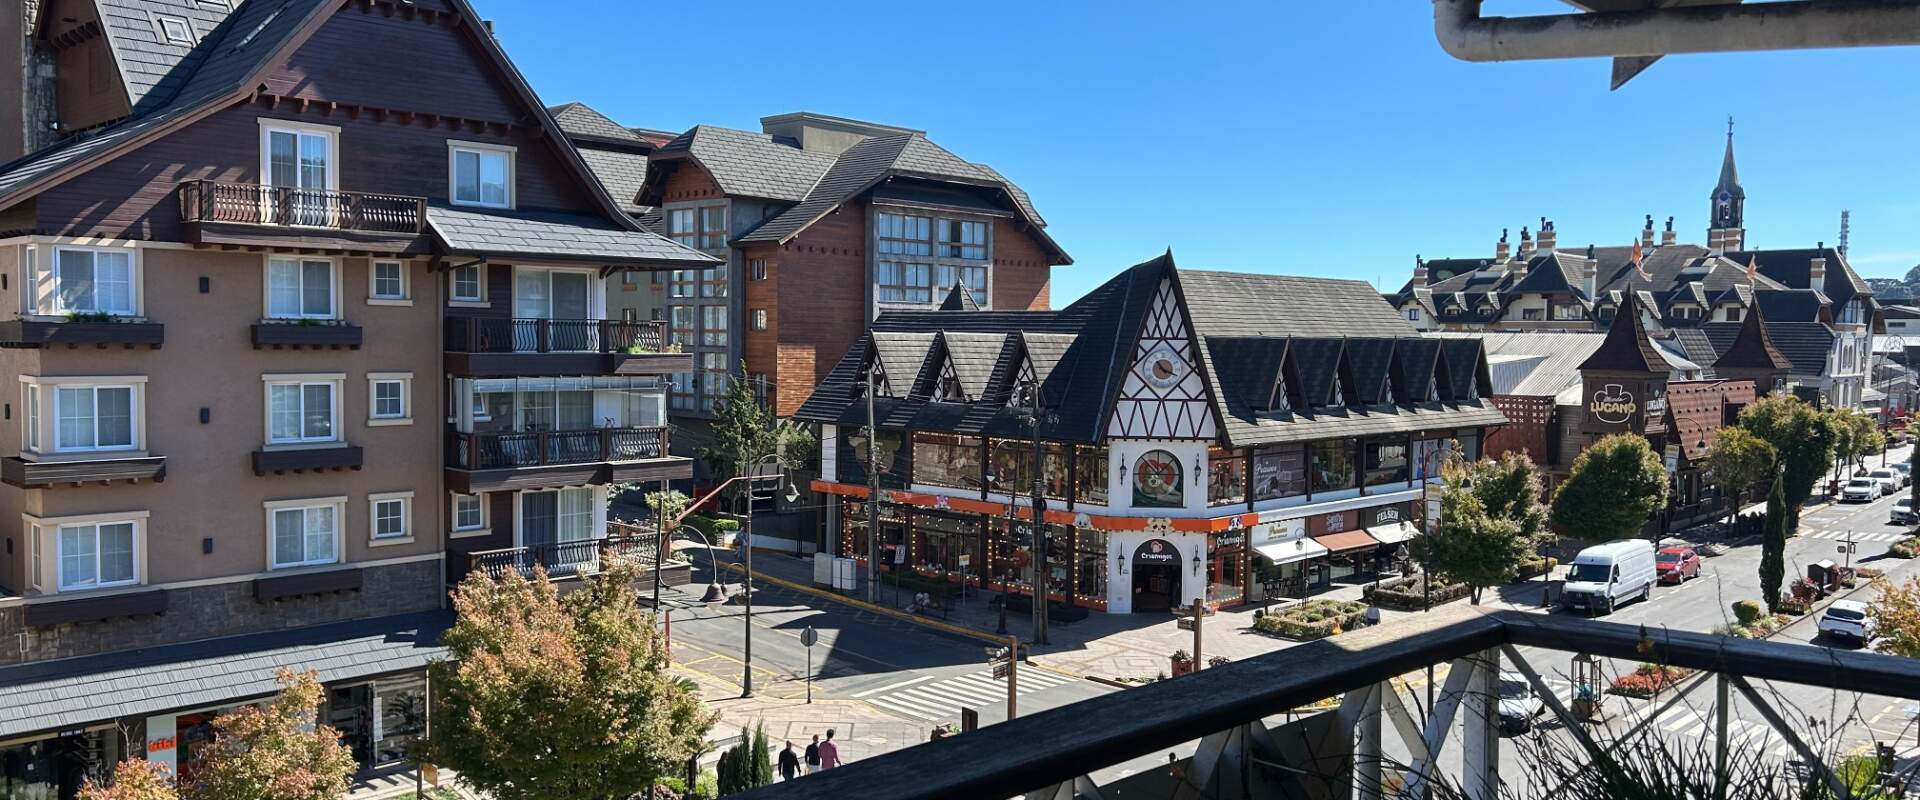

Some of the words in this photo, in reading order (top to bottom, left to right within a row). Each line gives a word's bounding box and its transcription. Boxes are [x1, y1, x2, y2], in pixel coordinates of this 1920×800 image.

[1590, 401, 1636, 413] LUGANO
[1376, 510, 1399, 522] FELSEN
[1141, 552, 1172, 562] Criamigos
